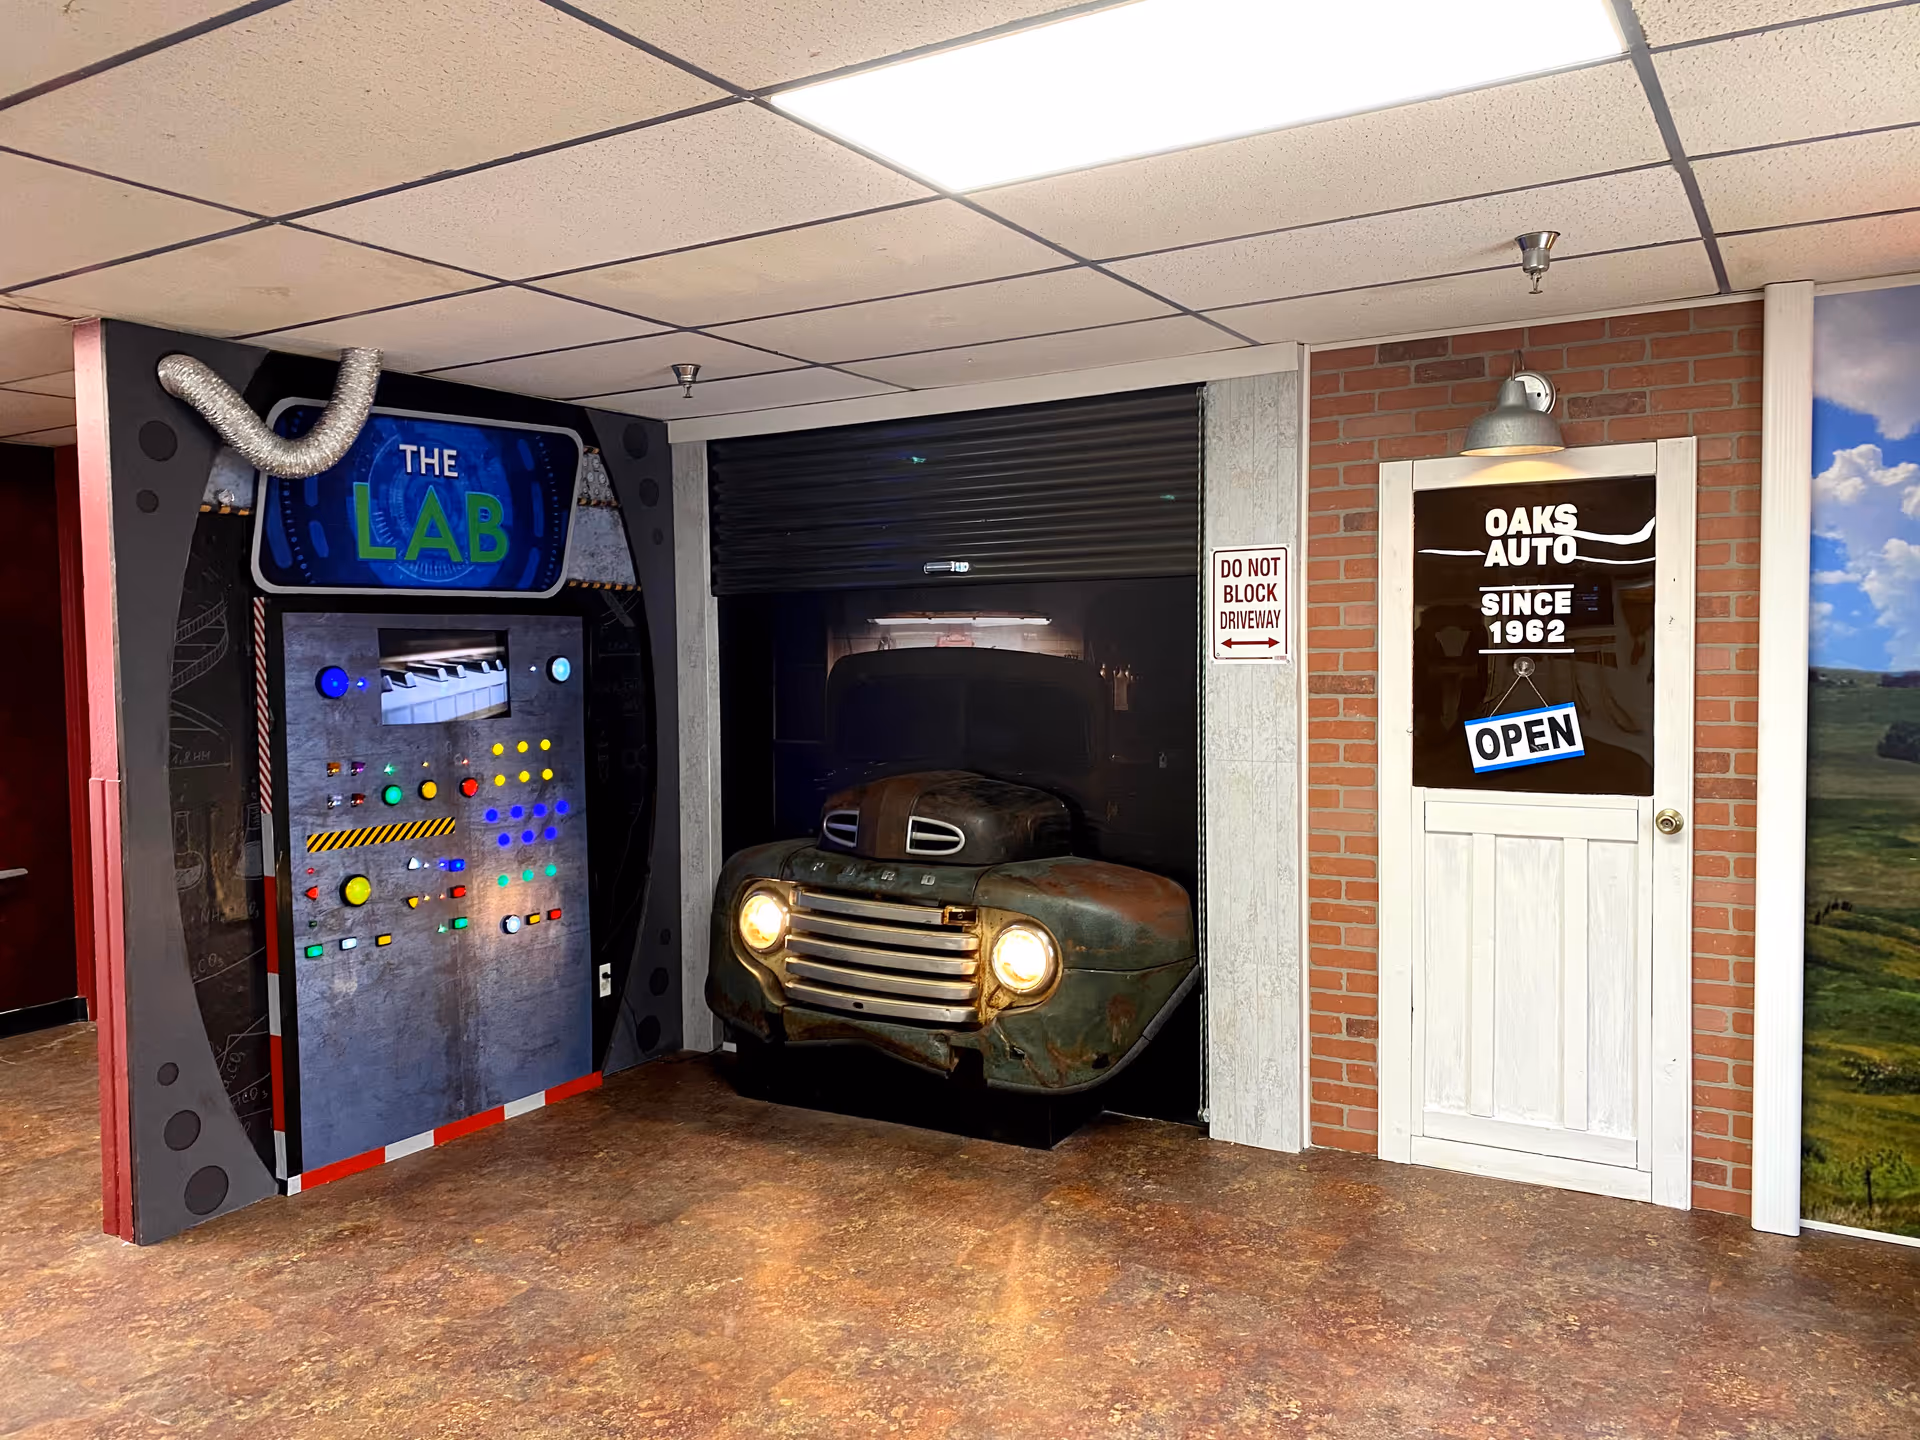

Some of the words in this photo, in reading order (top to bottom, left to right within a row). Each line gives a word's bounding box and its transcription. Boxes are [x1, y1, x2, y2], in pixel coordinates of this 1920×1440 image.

[399, 444, 459, 477] THE
[353, 482, 509, 563] LAB
[1485, 503, 1578, 537] OAKS
[1484, 535, 1577, 567] AUTO
[1221, 558, 1243, 579] DO
[1248, 557, 1281, 577] NOT
[1223, 583, 1278, 604] BLOCK
[1480, 590, 1572, 616] SINCE
[1220, 609, 1281, 630] DRIVEWAY
[1488, 619, 1565, 644] 1962
[1475, 713, 1577, 761] OPEN
